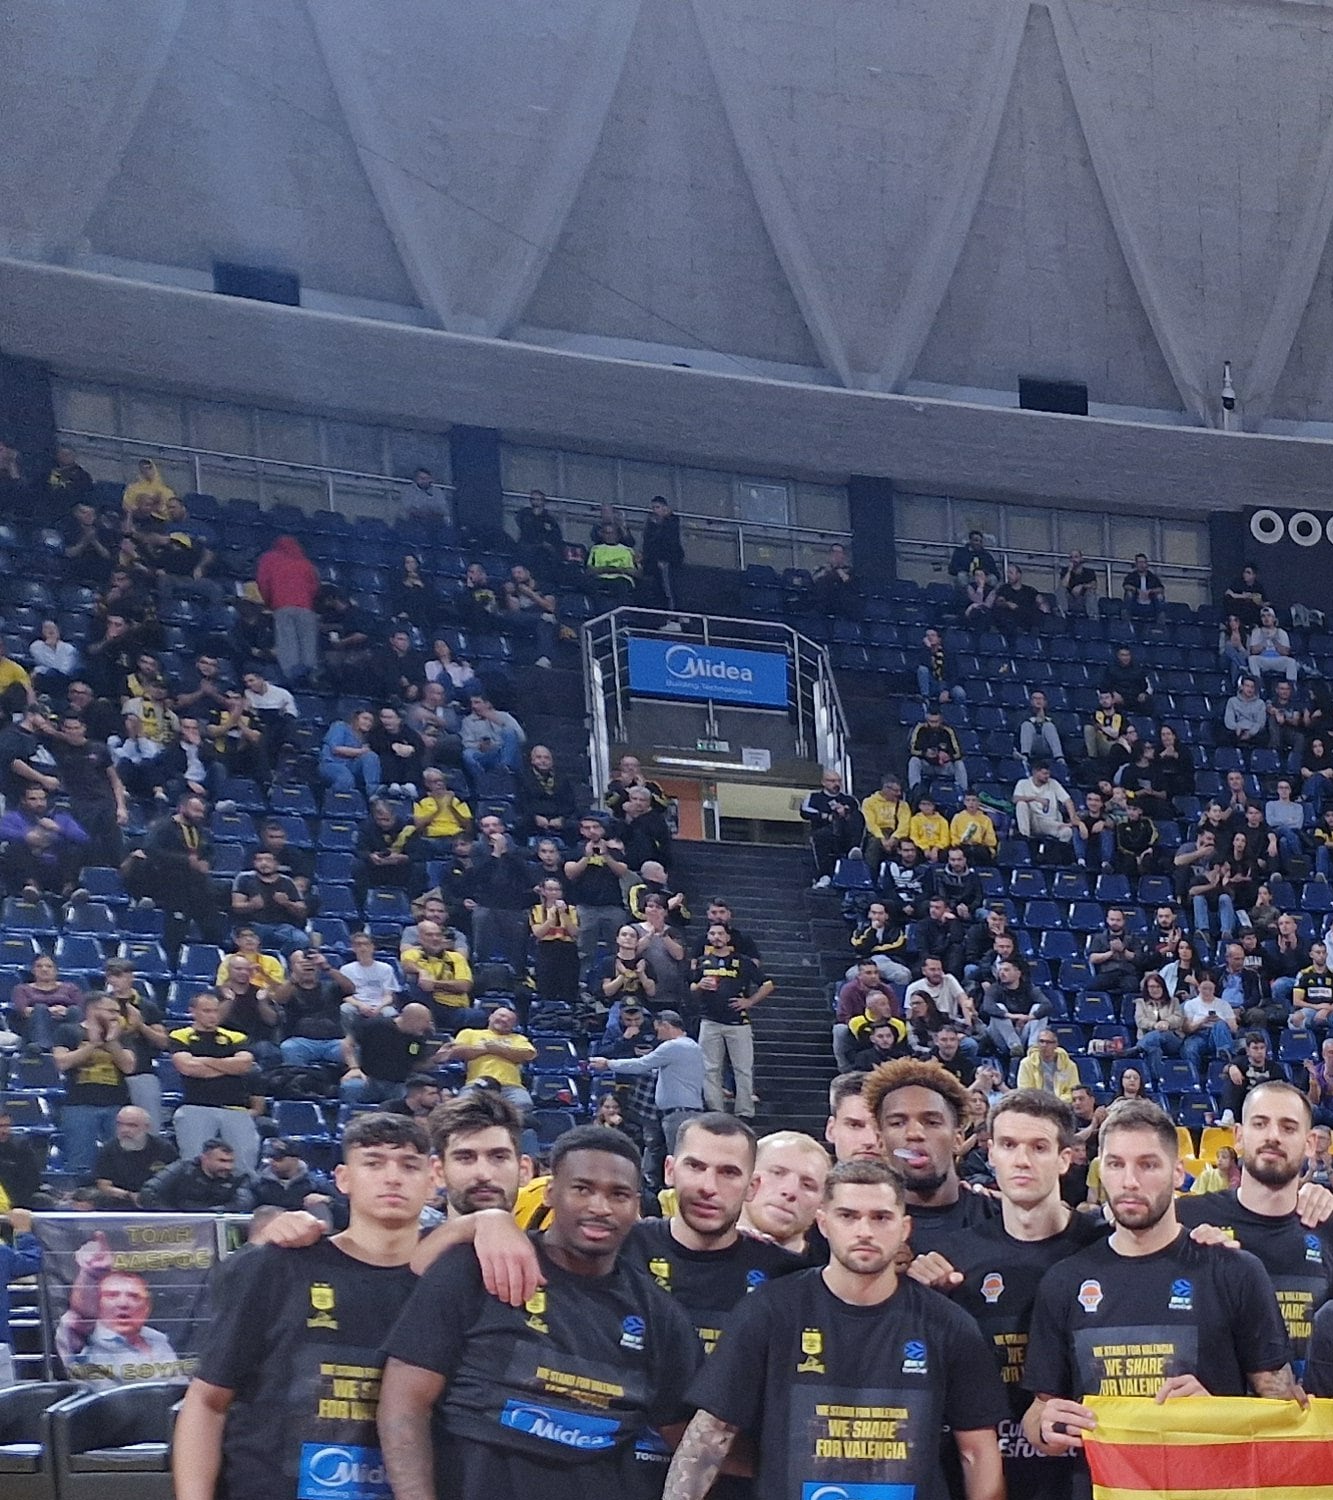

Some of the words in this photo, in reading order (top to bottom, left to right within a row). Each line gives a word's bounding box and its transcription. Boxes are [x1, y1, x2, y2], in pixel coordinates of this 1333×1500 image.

[680, 655, 752, 681] Midea
[1104, 1359, 1123, 1376] WE
[1125, 1357, 1164, 1375] SHARE
[828, 1419, 850, 1437] WE
[852, 1420, 897, 1439] SHARE
[815, 1438, 842, 1458] FOR
[842, 1440, 907, 1460] VALENCIA
